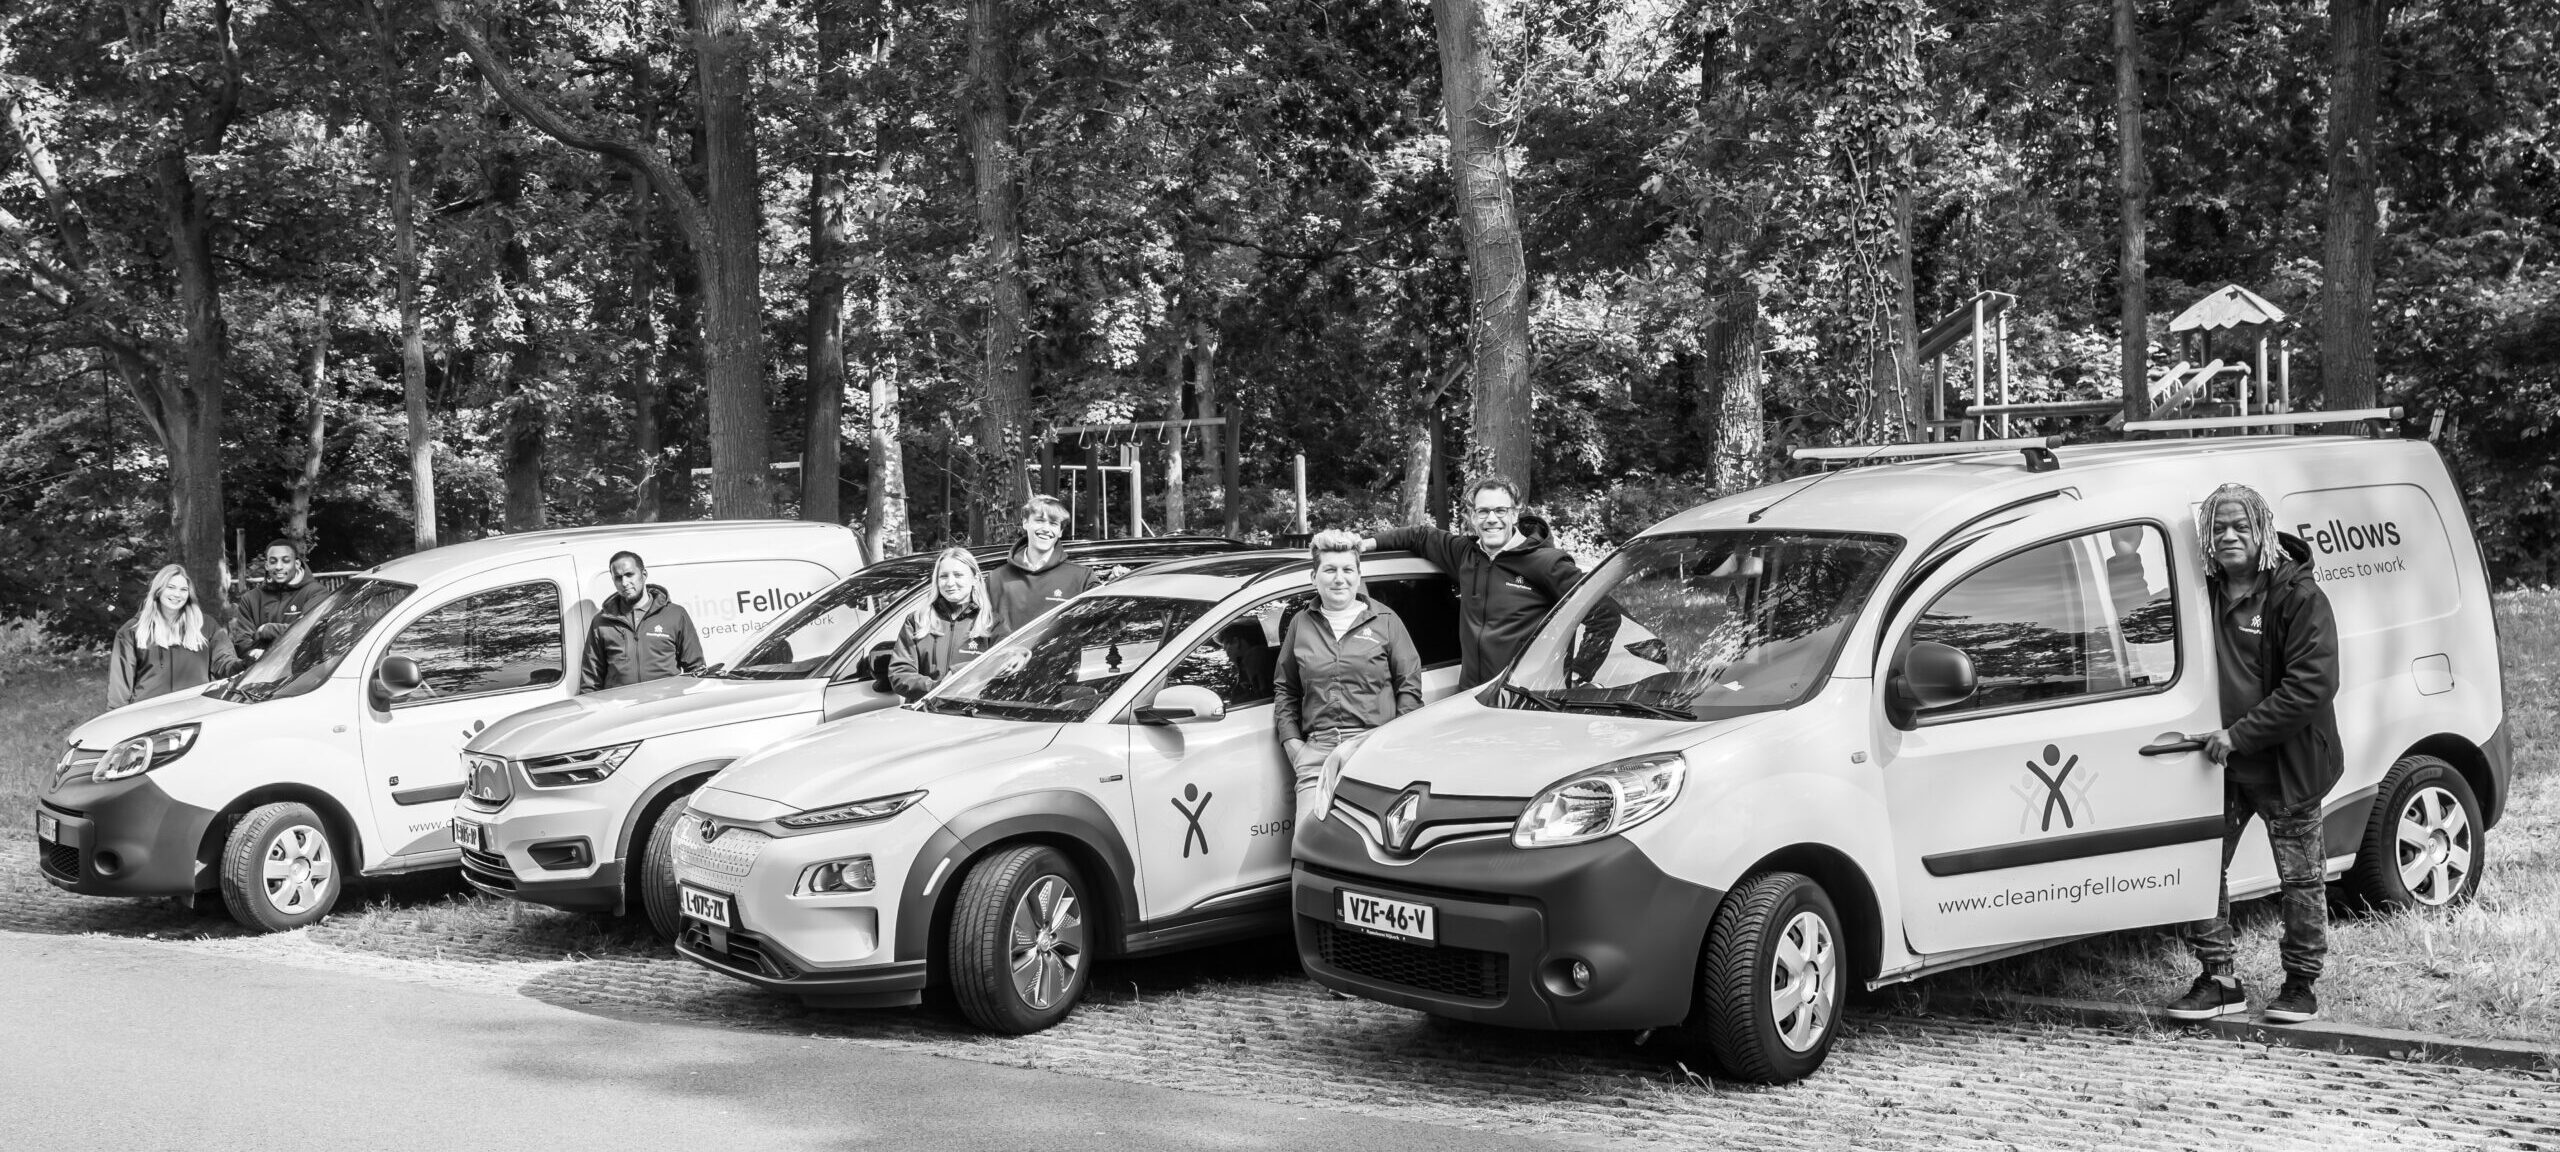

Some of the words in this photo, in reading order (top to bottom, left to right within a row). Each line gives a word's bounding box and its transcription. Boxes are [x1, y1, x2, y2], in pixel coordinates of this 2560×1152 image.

[2297, 519, 2401, 554] Fellows
[2357, 563, 2372, 577] to
[2374, 555, 2406, 574] work
[702, 622, 738, 638] great
[808, 614, 834, 626] ork
[1938, 868, 2181, 915] www.cleaningfellows.nl
[1349, 896, 1426, 933] VZF-46-V
